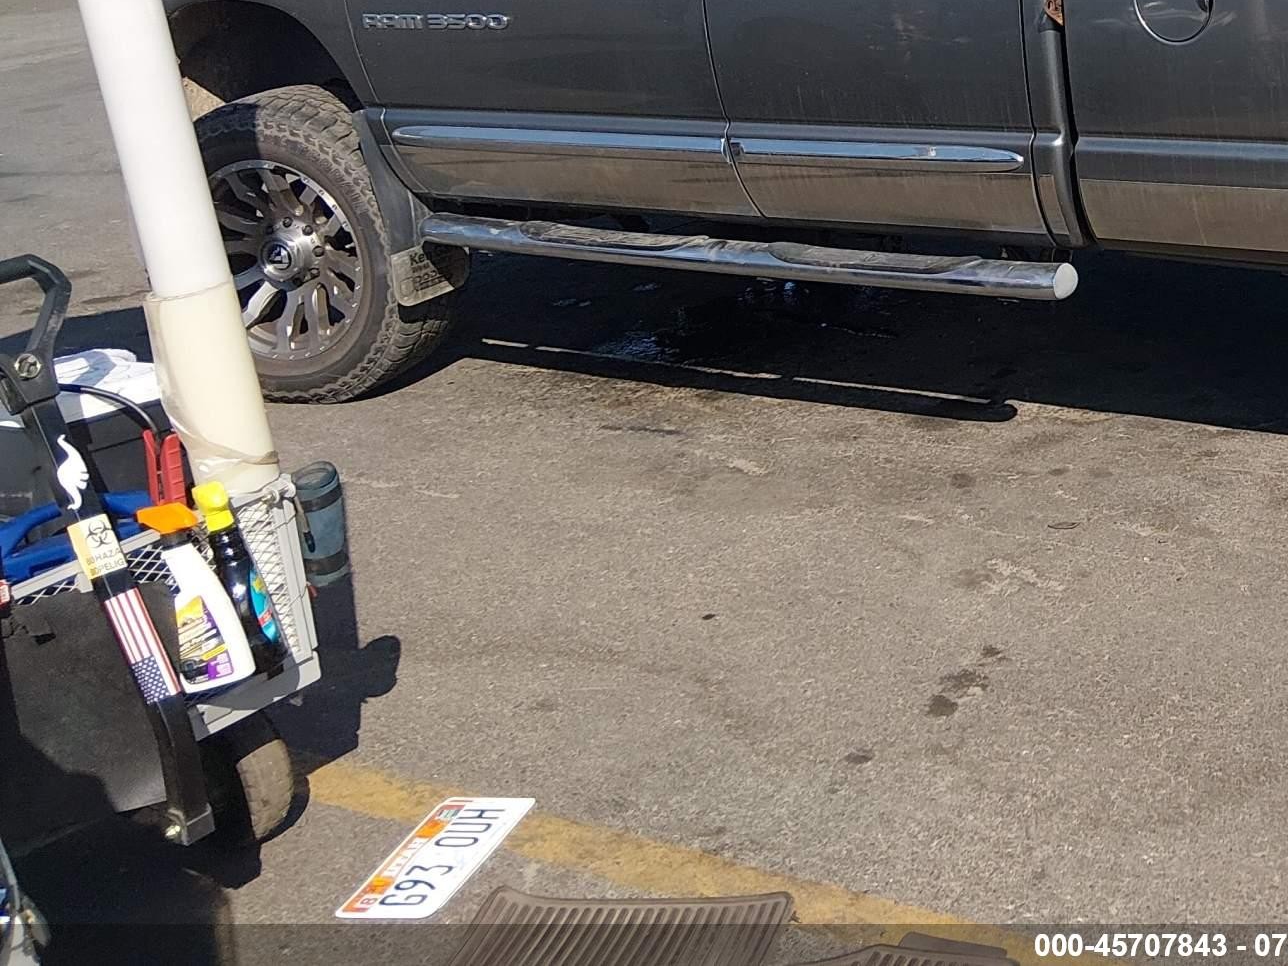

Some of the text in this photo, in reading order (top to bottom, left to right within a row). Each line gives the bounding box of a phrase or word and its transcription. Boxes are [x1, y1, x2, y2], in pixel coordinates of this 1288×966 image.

[362, 13, 509, 31] RAM 3500
[378, 865, 454, 907] G93
